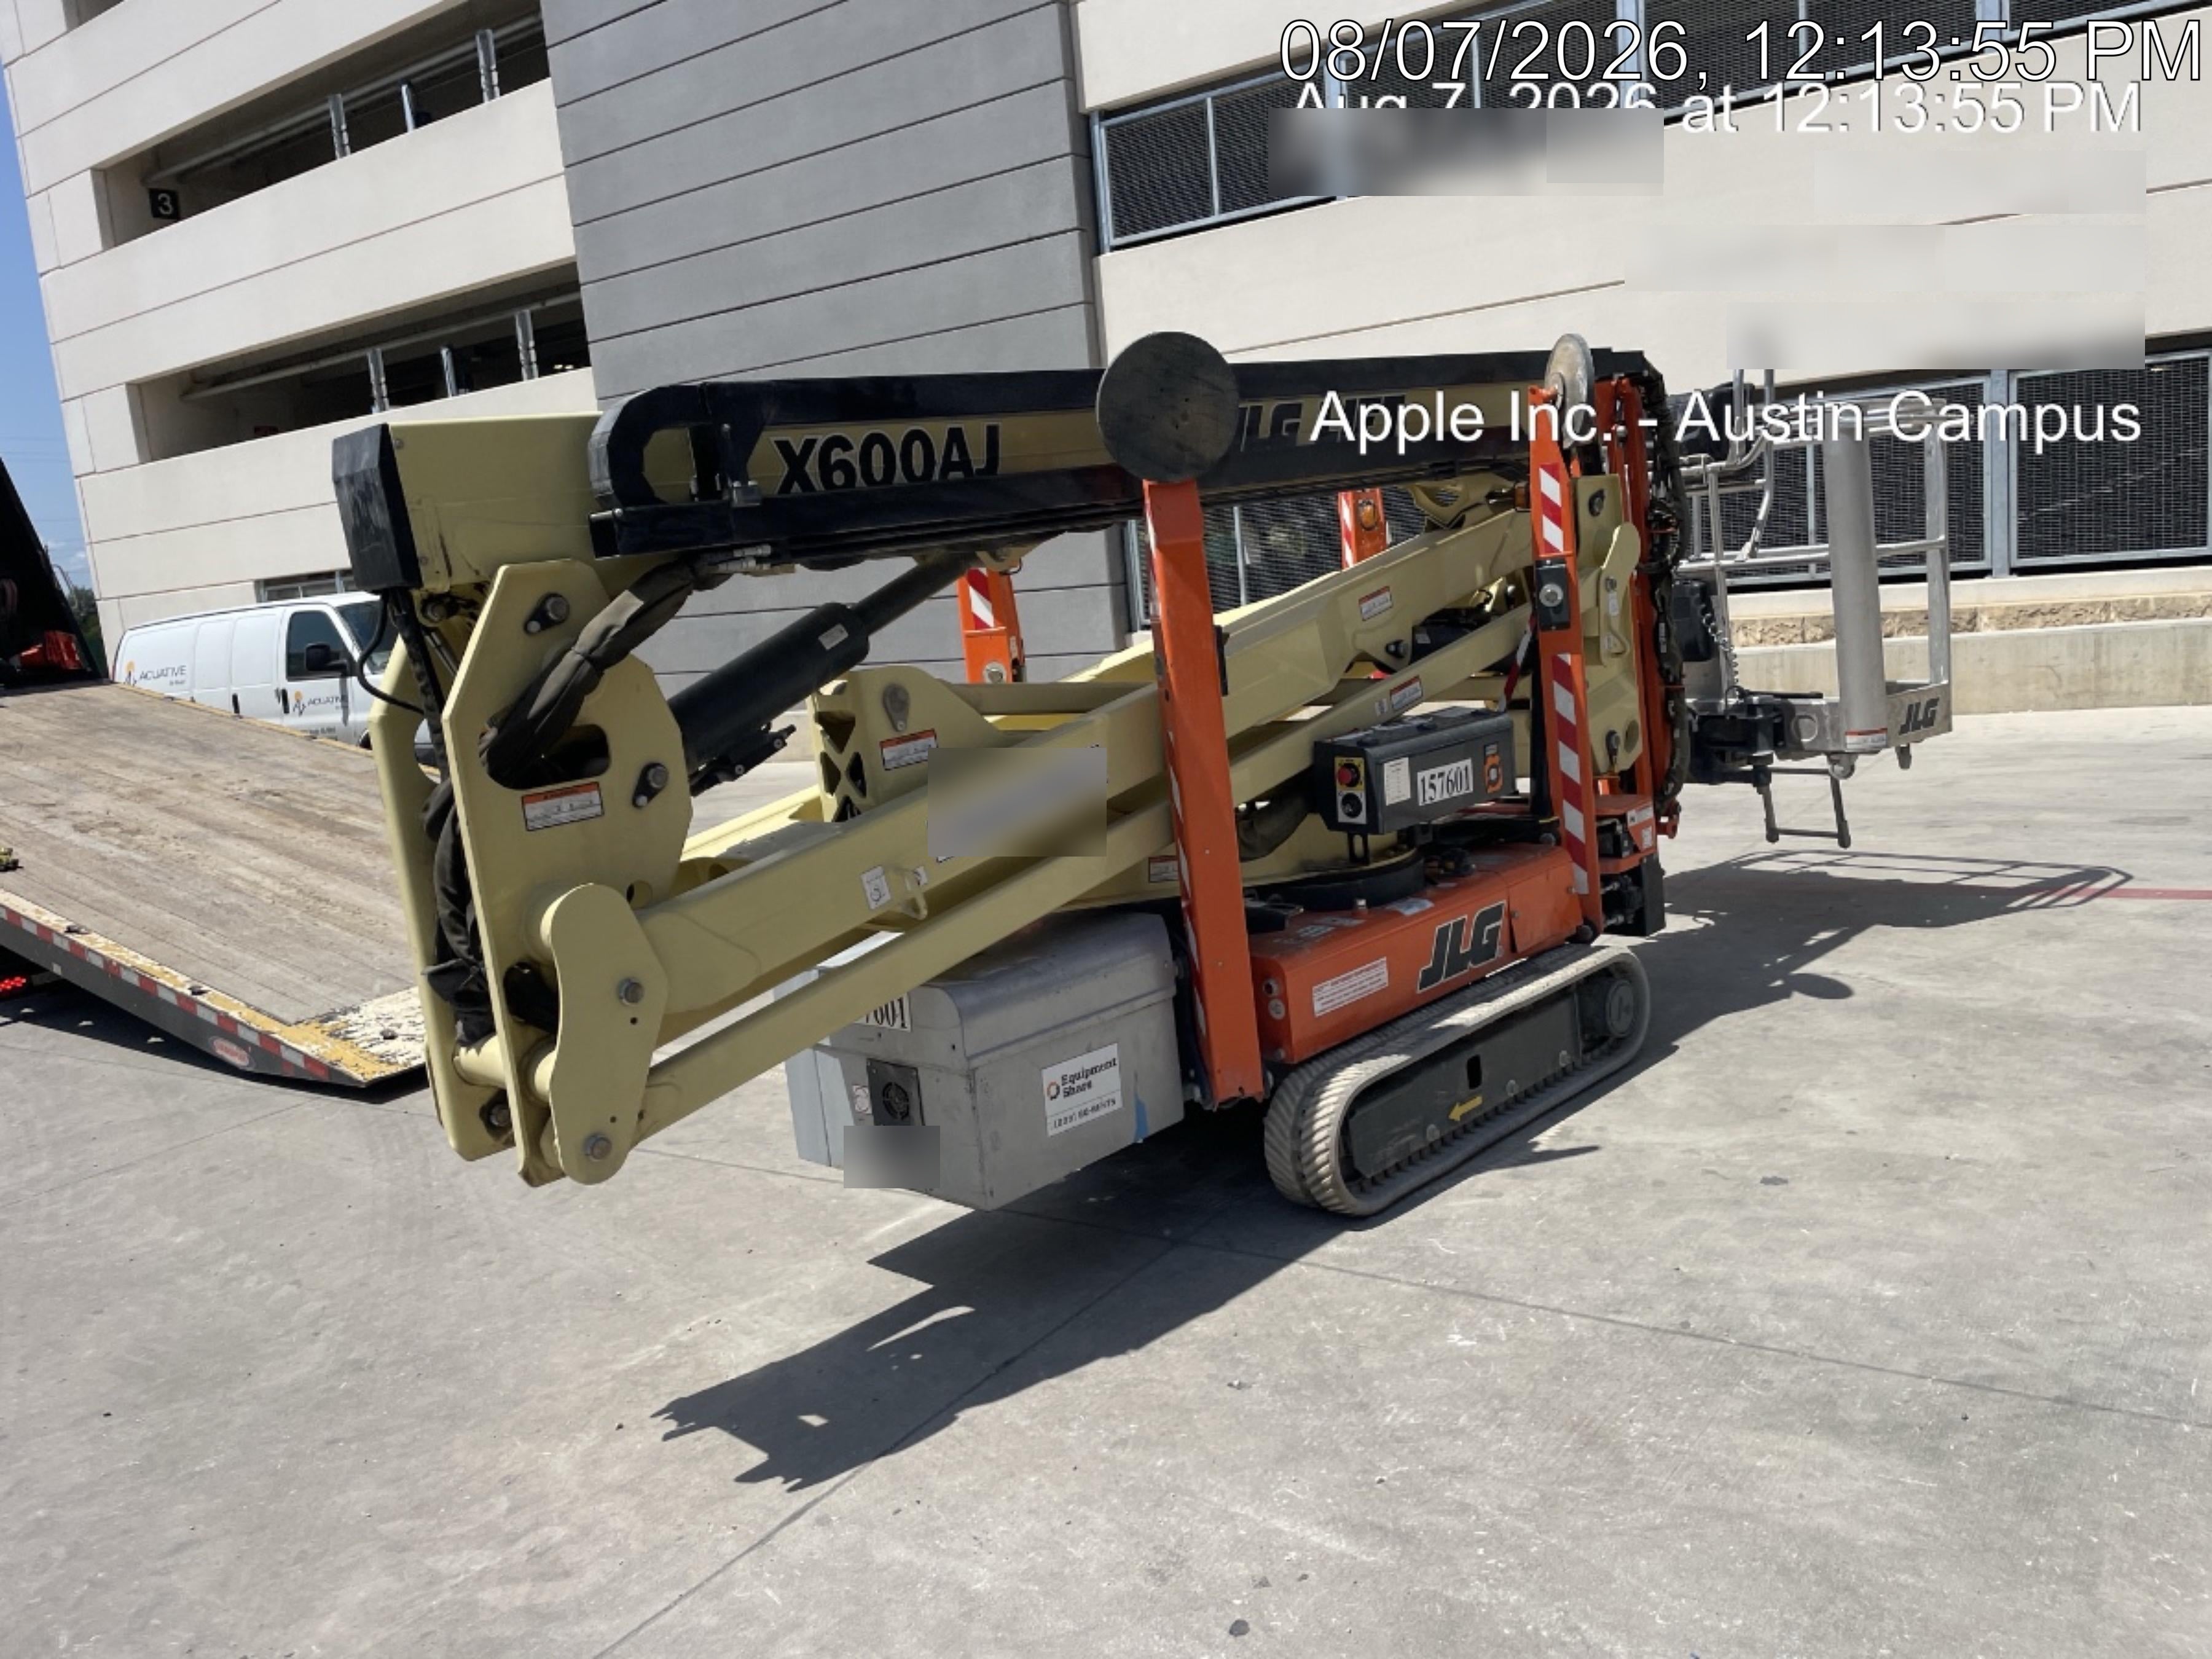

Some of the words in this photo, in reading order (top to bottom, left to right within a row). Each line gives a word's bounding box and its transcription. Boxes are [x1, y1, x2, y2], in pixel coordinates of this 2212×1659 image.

[158, 192, 174, 215] 3
[771, 422, 1002, 495] X600AJ
[1898, 697, 1940, 735] JLG
[1420, 764, 1472, 804] 157601
[1417, 900, 1507, 994] JLG
[1061, 1057, 1118, 1086] Equipment
[1063, 1080, 1092, 1099] Share
